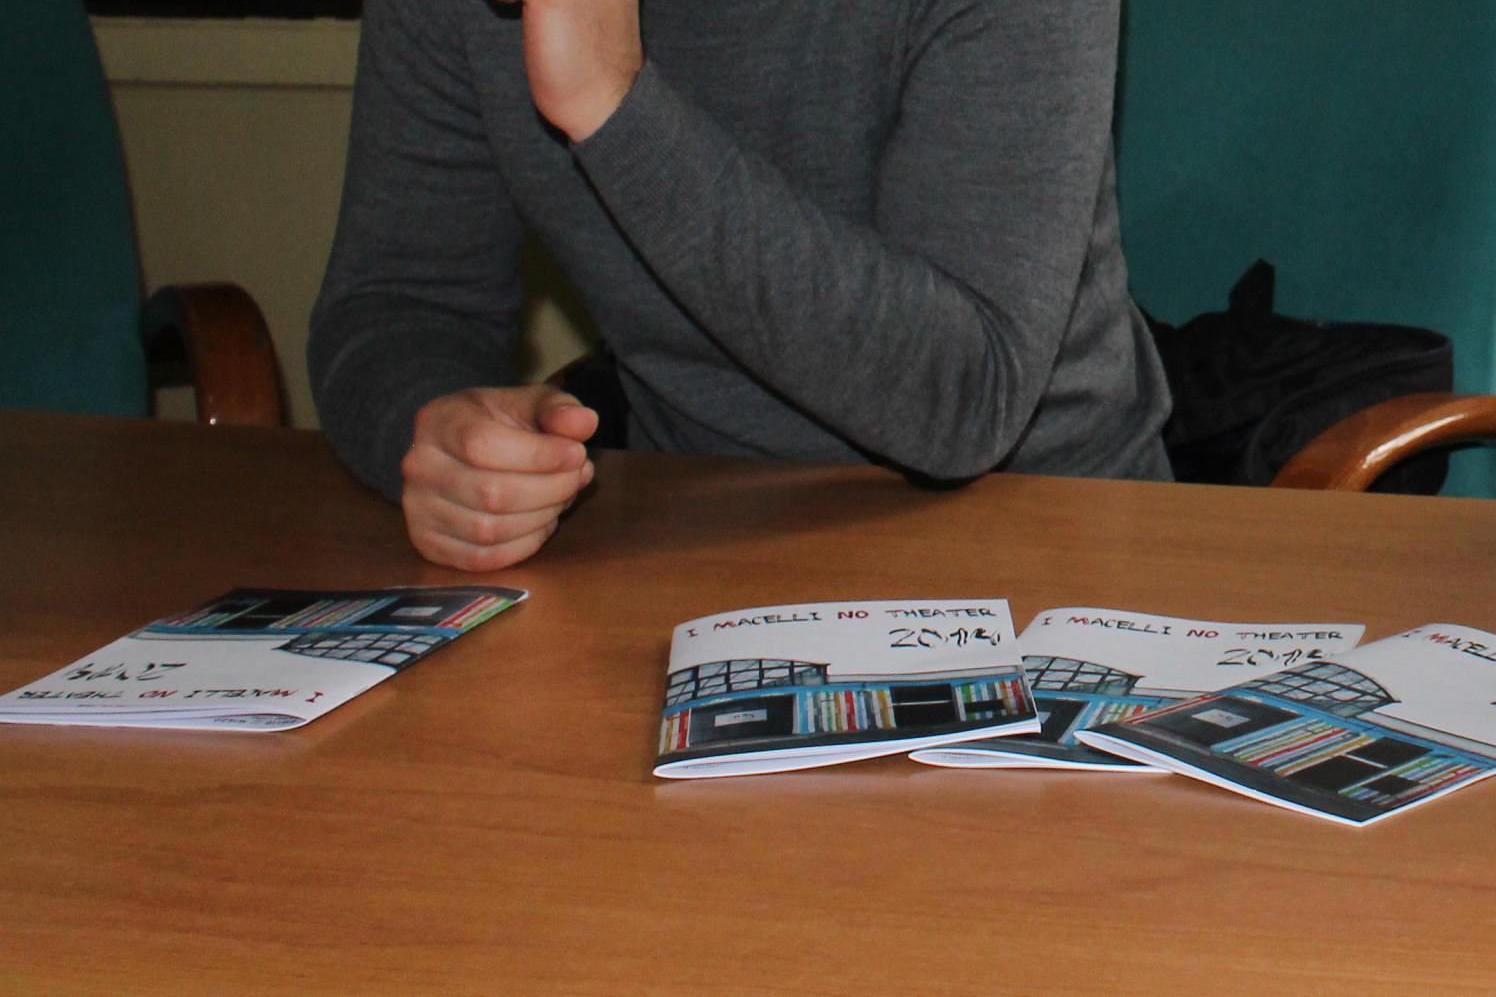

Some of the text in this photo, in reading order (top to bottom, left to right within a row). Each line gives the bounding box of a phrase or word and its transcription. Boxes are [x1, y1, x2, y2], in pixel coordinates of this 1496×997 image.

[687, 608, 998, 638] I MACELLI NO THEATER
[1042, 616, 1343, 641] I MACELLI NO THEATER
[17, 689, 324, 703] I MACELLI NO THEATER
